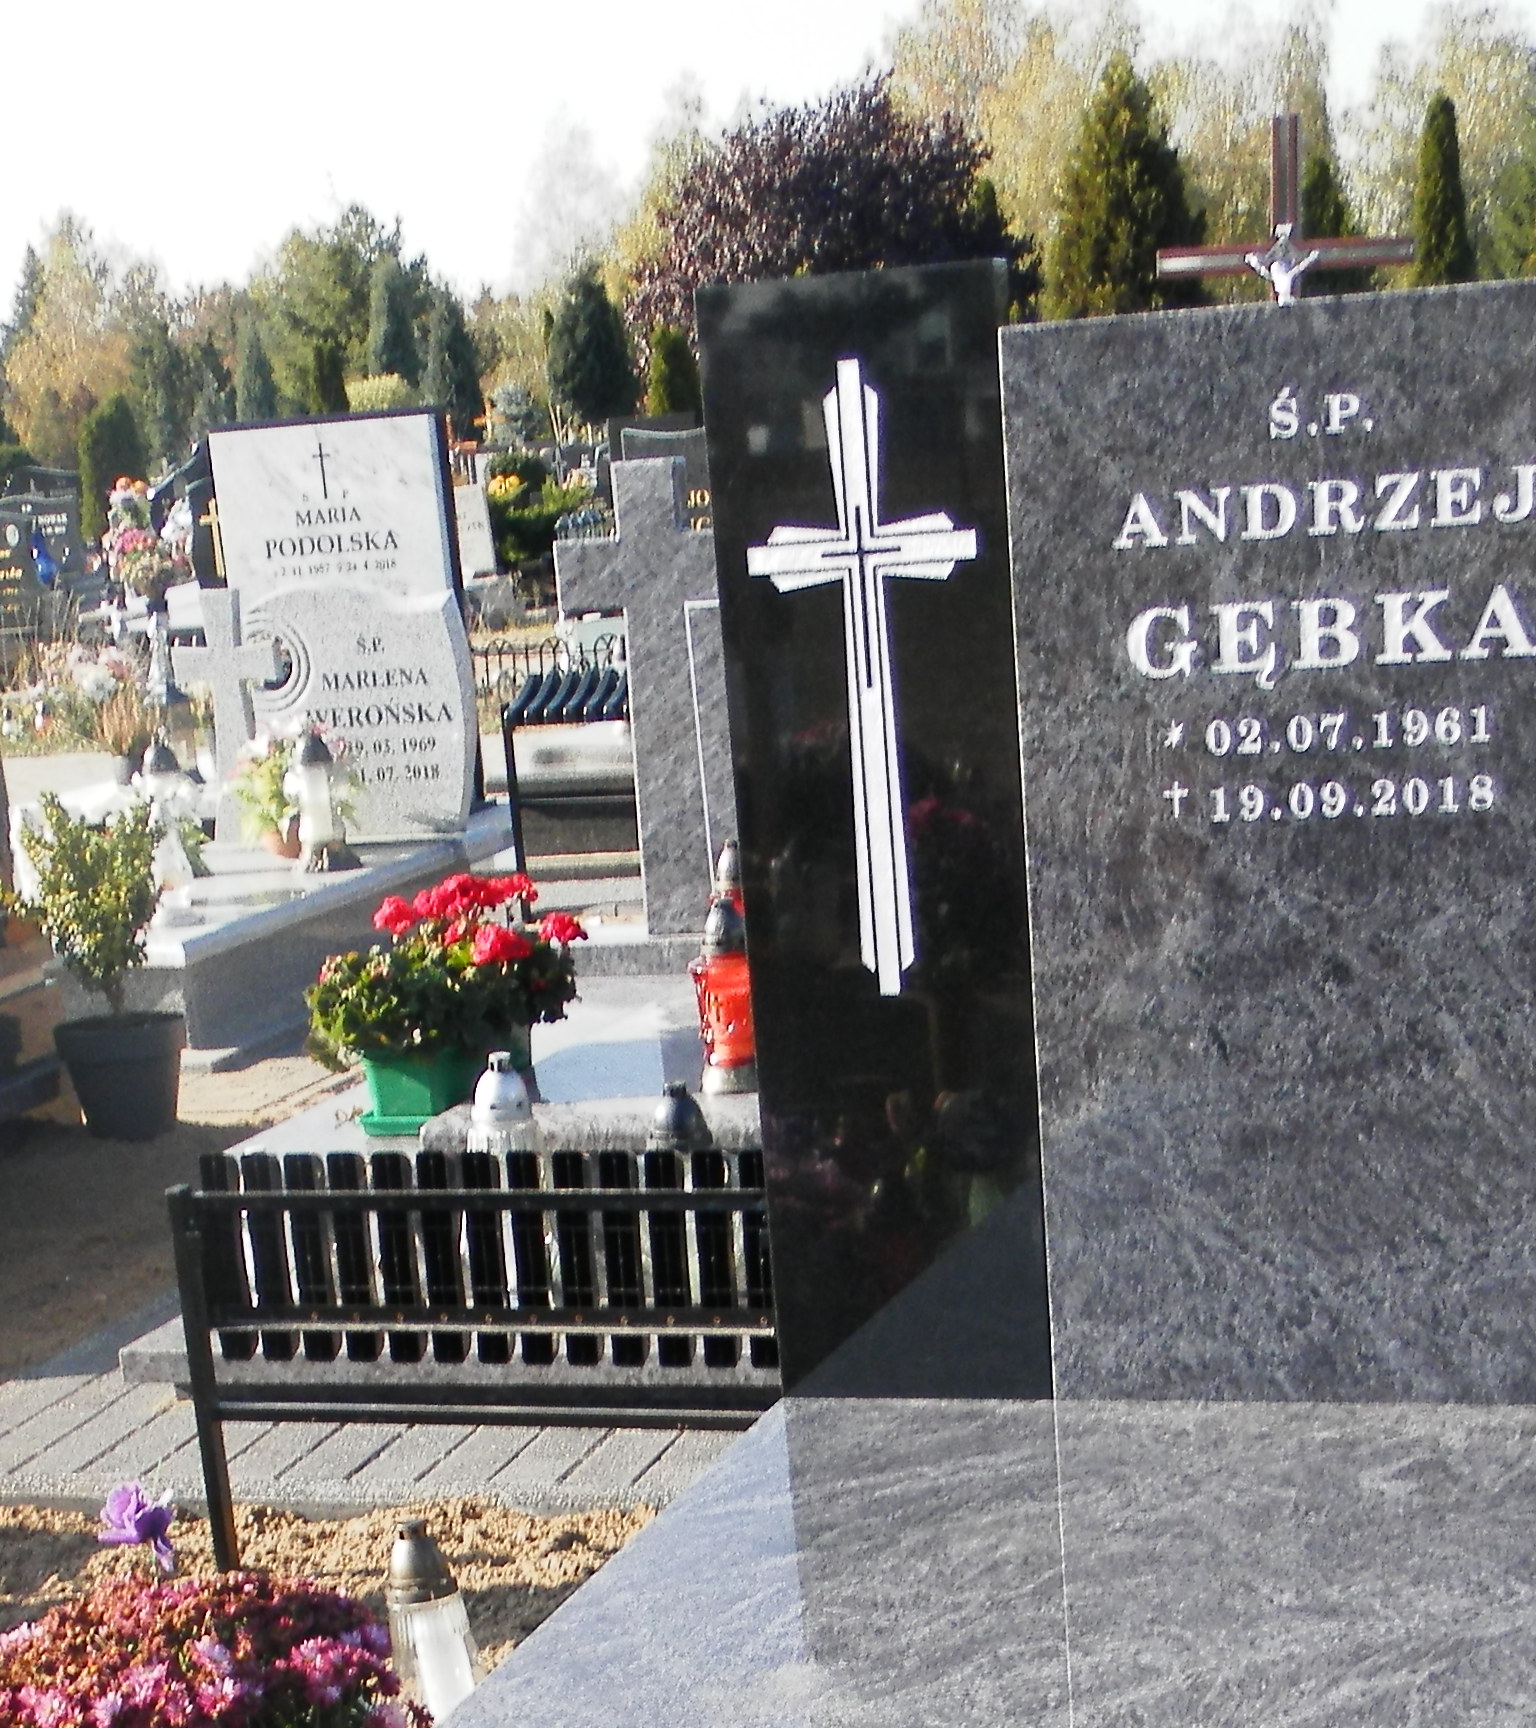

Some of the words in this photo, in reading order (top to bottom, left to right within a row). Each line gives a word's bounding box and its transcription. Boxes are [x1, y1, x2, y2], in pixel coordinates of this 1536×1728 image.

[1268, 386, 1375, 439] Ś.P.
[295, 506, 361, 528] MARIA
[265, 529, 399, 559] PODOLSKA
[322, 667, 428, 692] MARLENA
[1204, 704, 1492, 756] 02.07.1961
[1209, 774, 1496, 823] 19.09.2018
